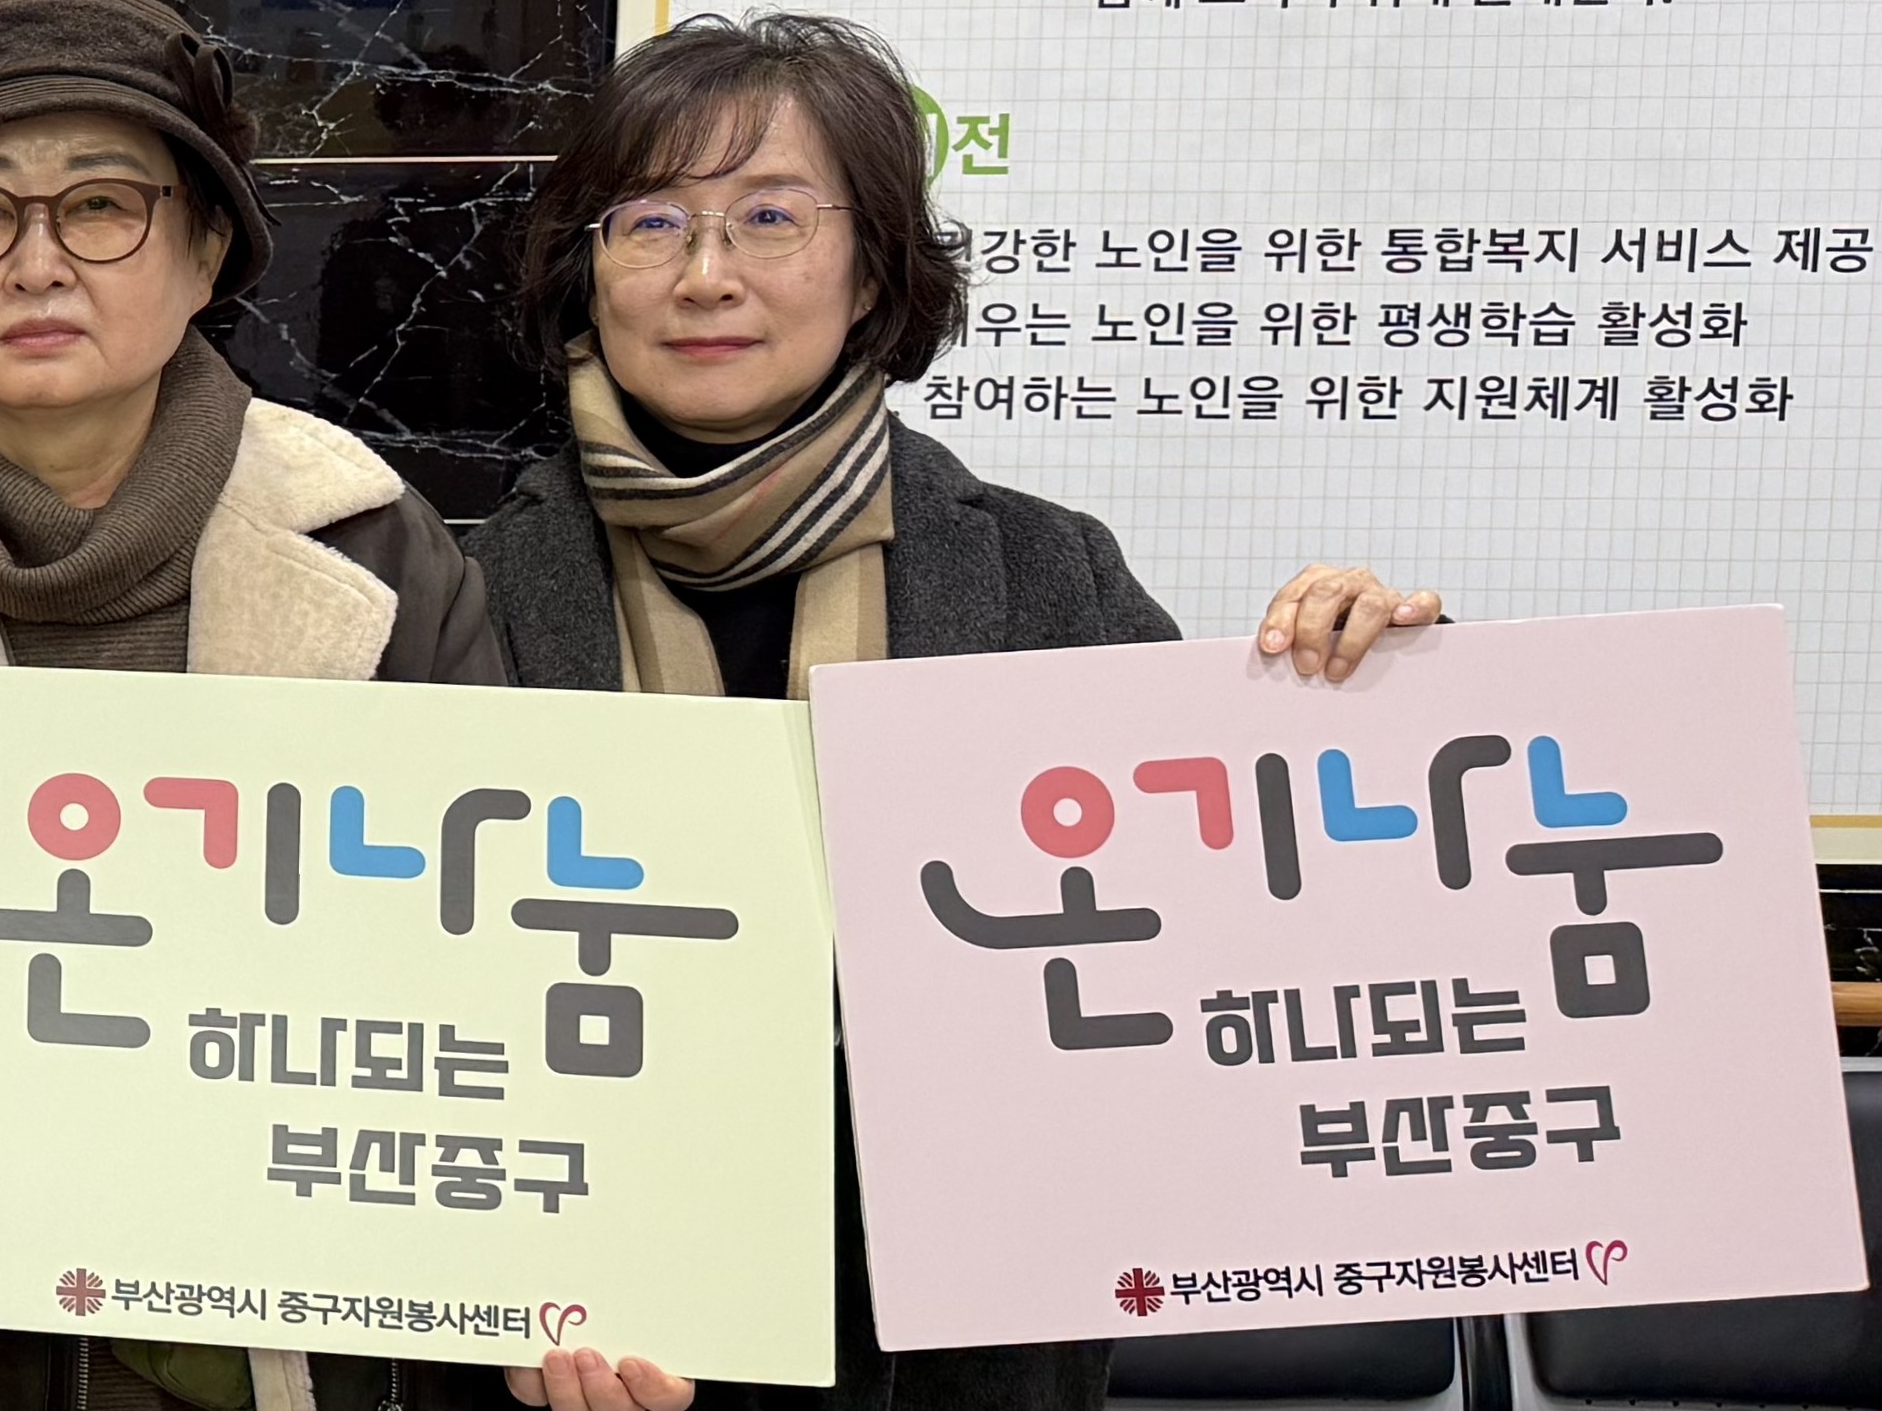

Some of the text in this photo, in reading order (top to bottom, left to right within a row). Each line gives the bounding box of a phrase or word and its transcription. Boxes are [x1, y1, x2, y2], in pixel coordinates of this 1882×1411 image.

[1095, 228, 1243, 273] 노인을
[1264, 228, 1362, 274] 위한
[1381, 227, 1579, 274] 통합복지
[1601, 227, 1752, 273] 서비스
[1773, 227, 1874, 273] 제공
[951, 300, 1748, 353] 우는 노인을 위한 평생학습 활성화
[924, 375, 1794, 422] 참여하는 노인을 위한 지원체계 활성화
[920, 734, 1724, 1052] 온기나눔
[188, 1007, 510, 1102] 하나되는
[1199, 975, 1528, 1068] 하나되는
[265, 1123, 591, 1215] 부산중구
[1298, 1084, 1622, 1179] 부산중구
[111, 1277, 532, 1340] 부산광역시 중구자원봉사센터
[1169, 1243, 1580, 1306] 부산광역시 중구자원봉사센터
